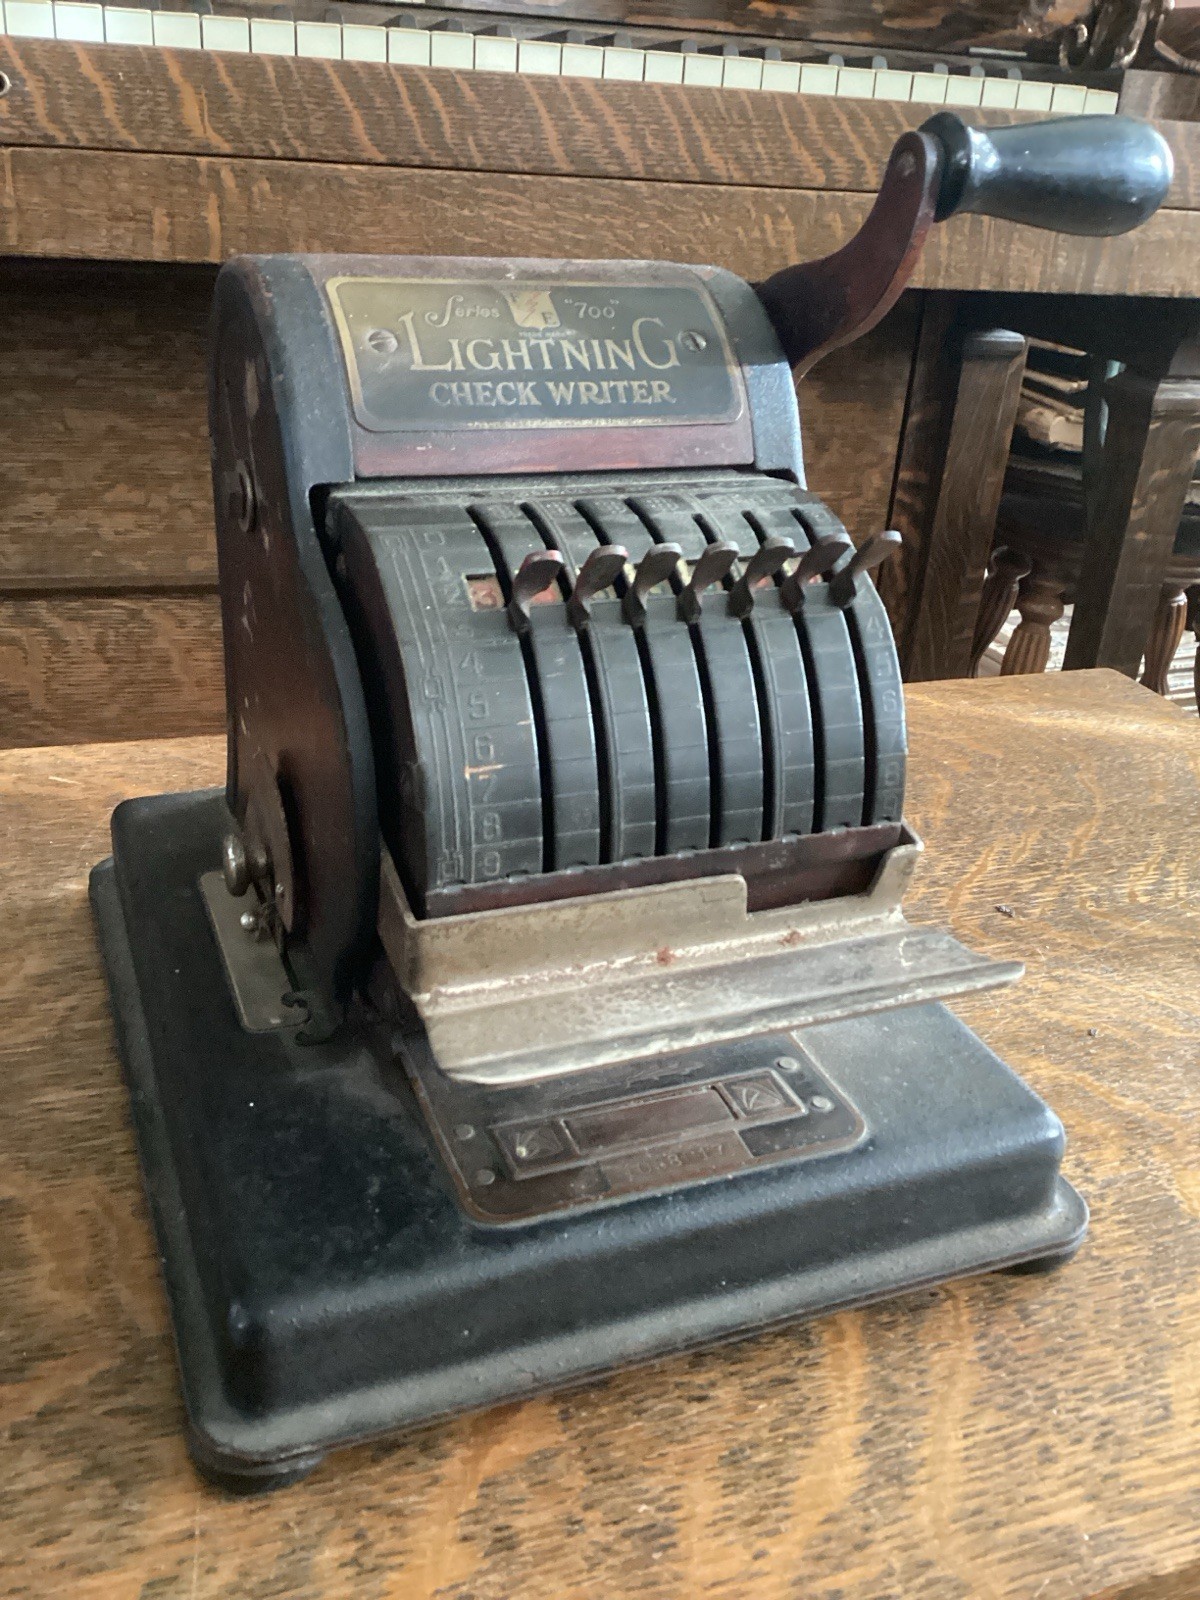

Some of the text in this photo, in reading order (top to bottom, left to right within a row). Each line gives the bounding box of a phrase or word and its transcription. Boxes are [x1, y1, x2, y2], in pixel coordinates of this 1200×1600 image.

[425, 295, 501, 328] Series
[399, 311, 681, 373] LIGHTNING
[429, 379, 677, 407] CHECK WRITER
[473, 583, 498, 610] 3
[866, 616, 884, 639] 4
[881, 688, 898, 713] 6
[474, 732, 495, 763] 6
[482, 812, 501, 841] 8
[483, 850, 501, 878] 9
